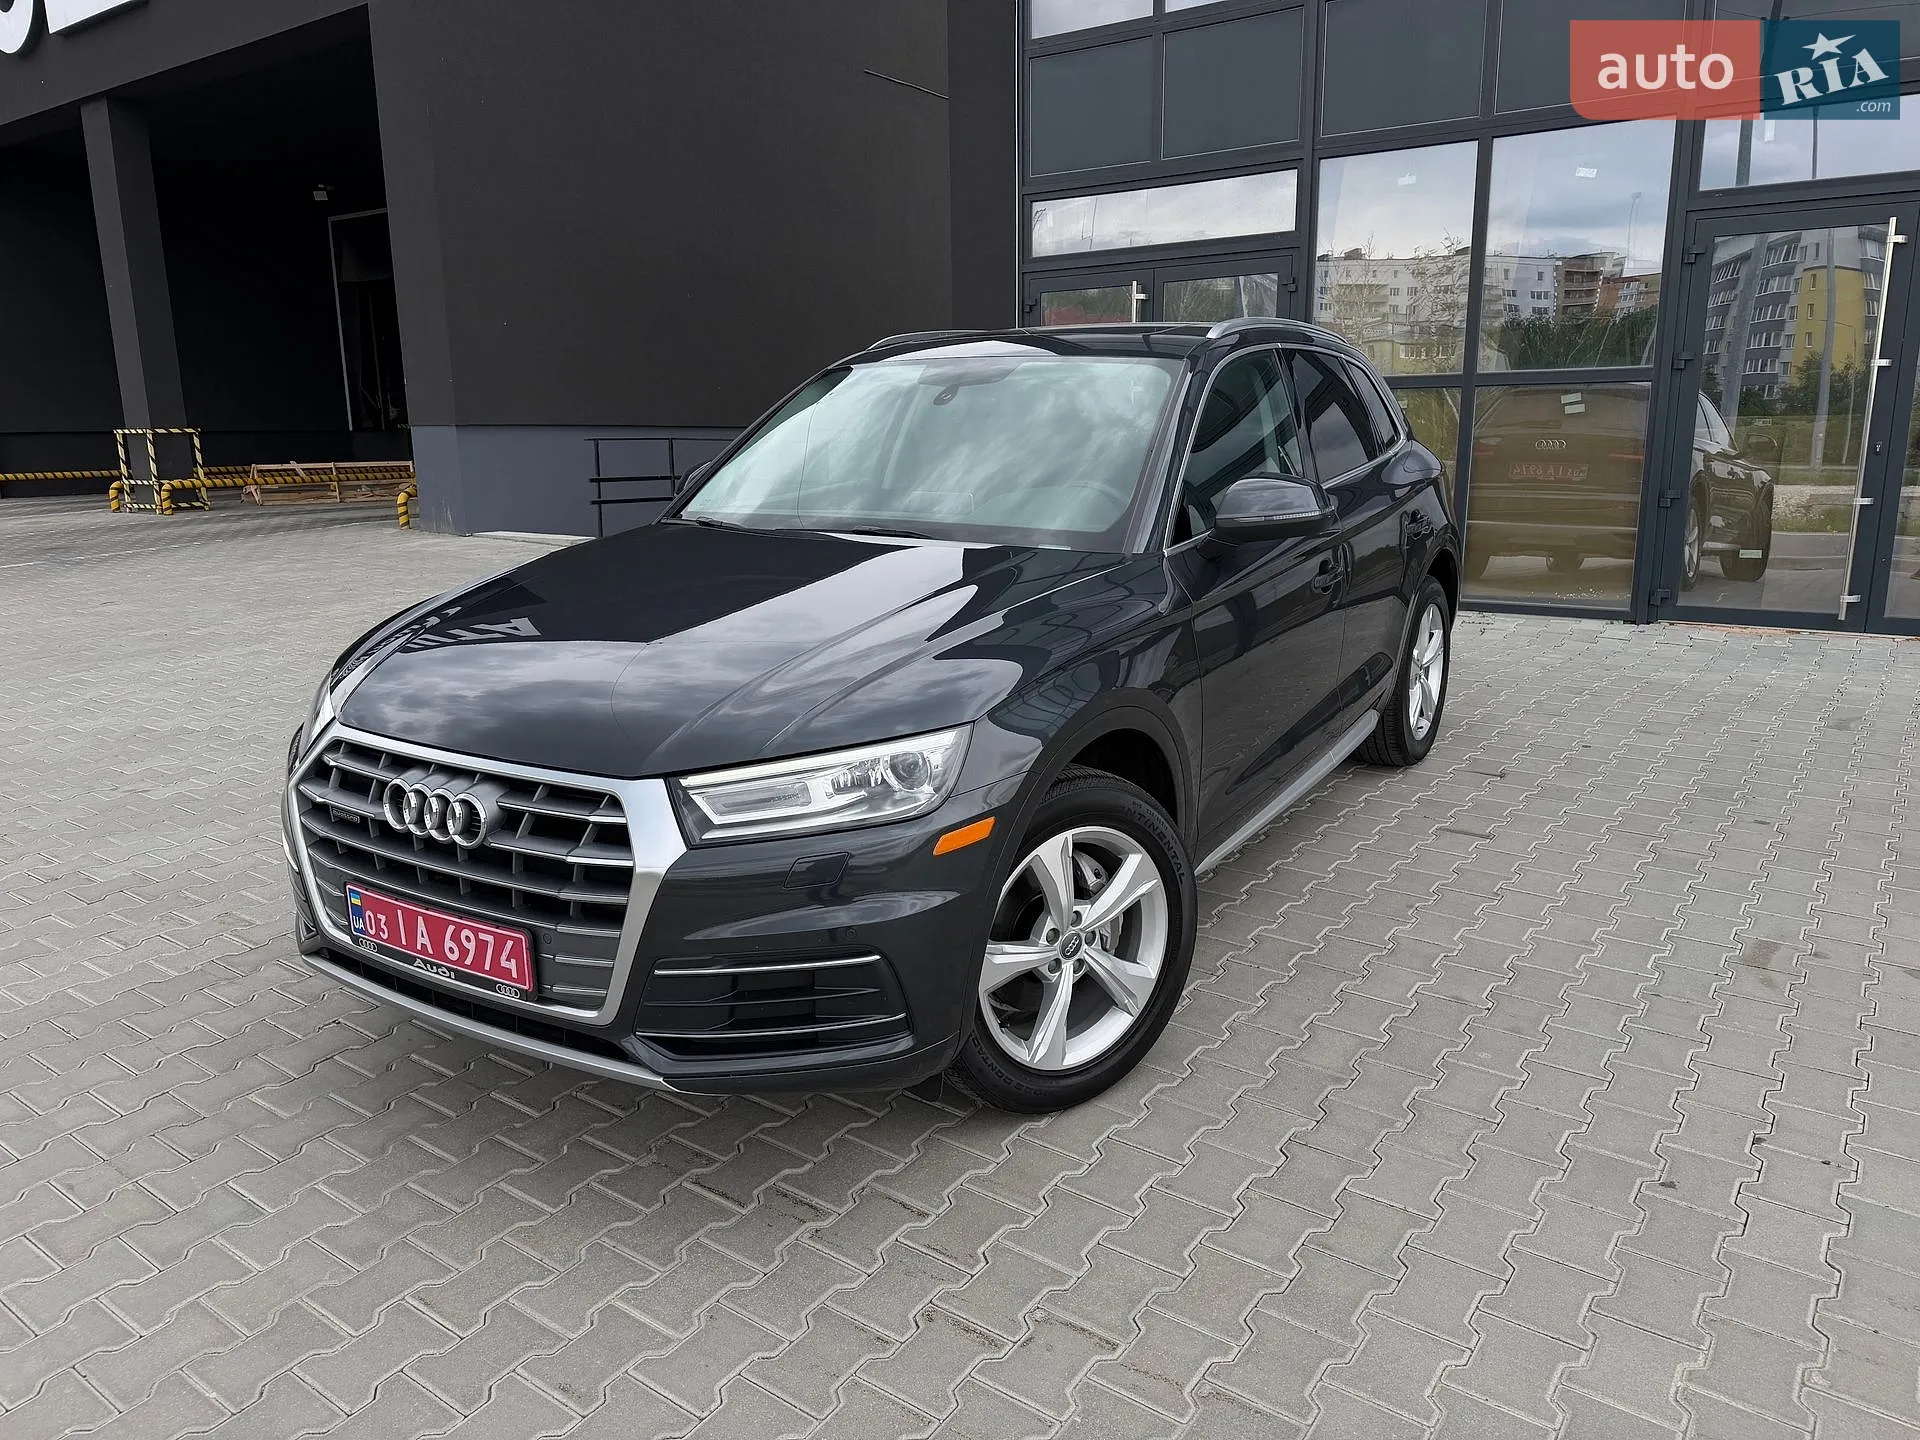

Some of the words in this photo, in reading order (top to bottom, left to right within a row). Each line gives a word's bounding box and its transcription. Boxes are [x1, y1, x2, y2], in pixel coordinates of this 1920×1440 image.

[352, 915, 366, 931] UA
[365, 910, 389, 940] 03
[444, 924, 518, 979] 6974
